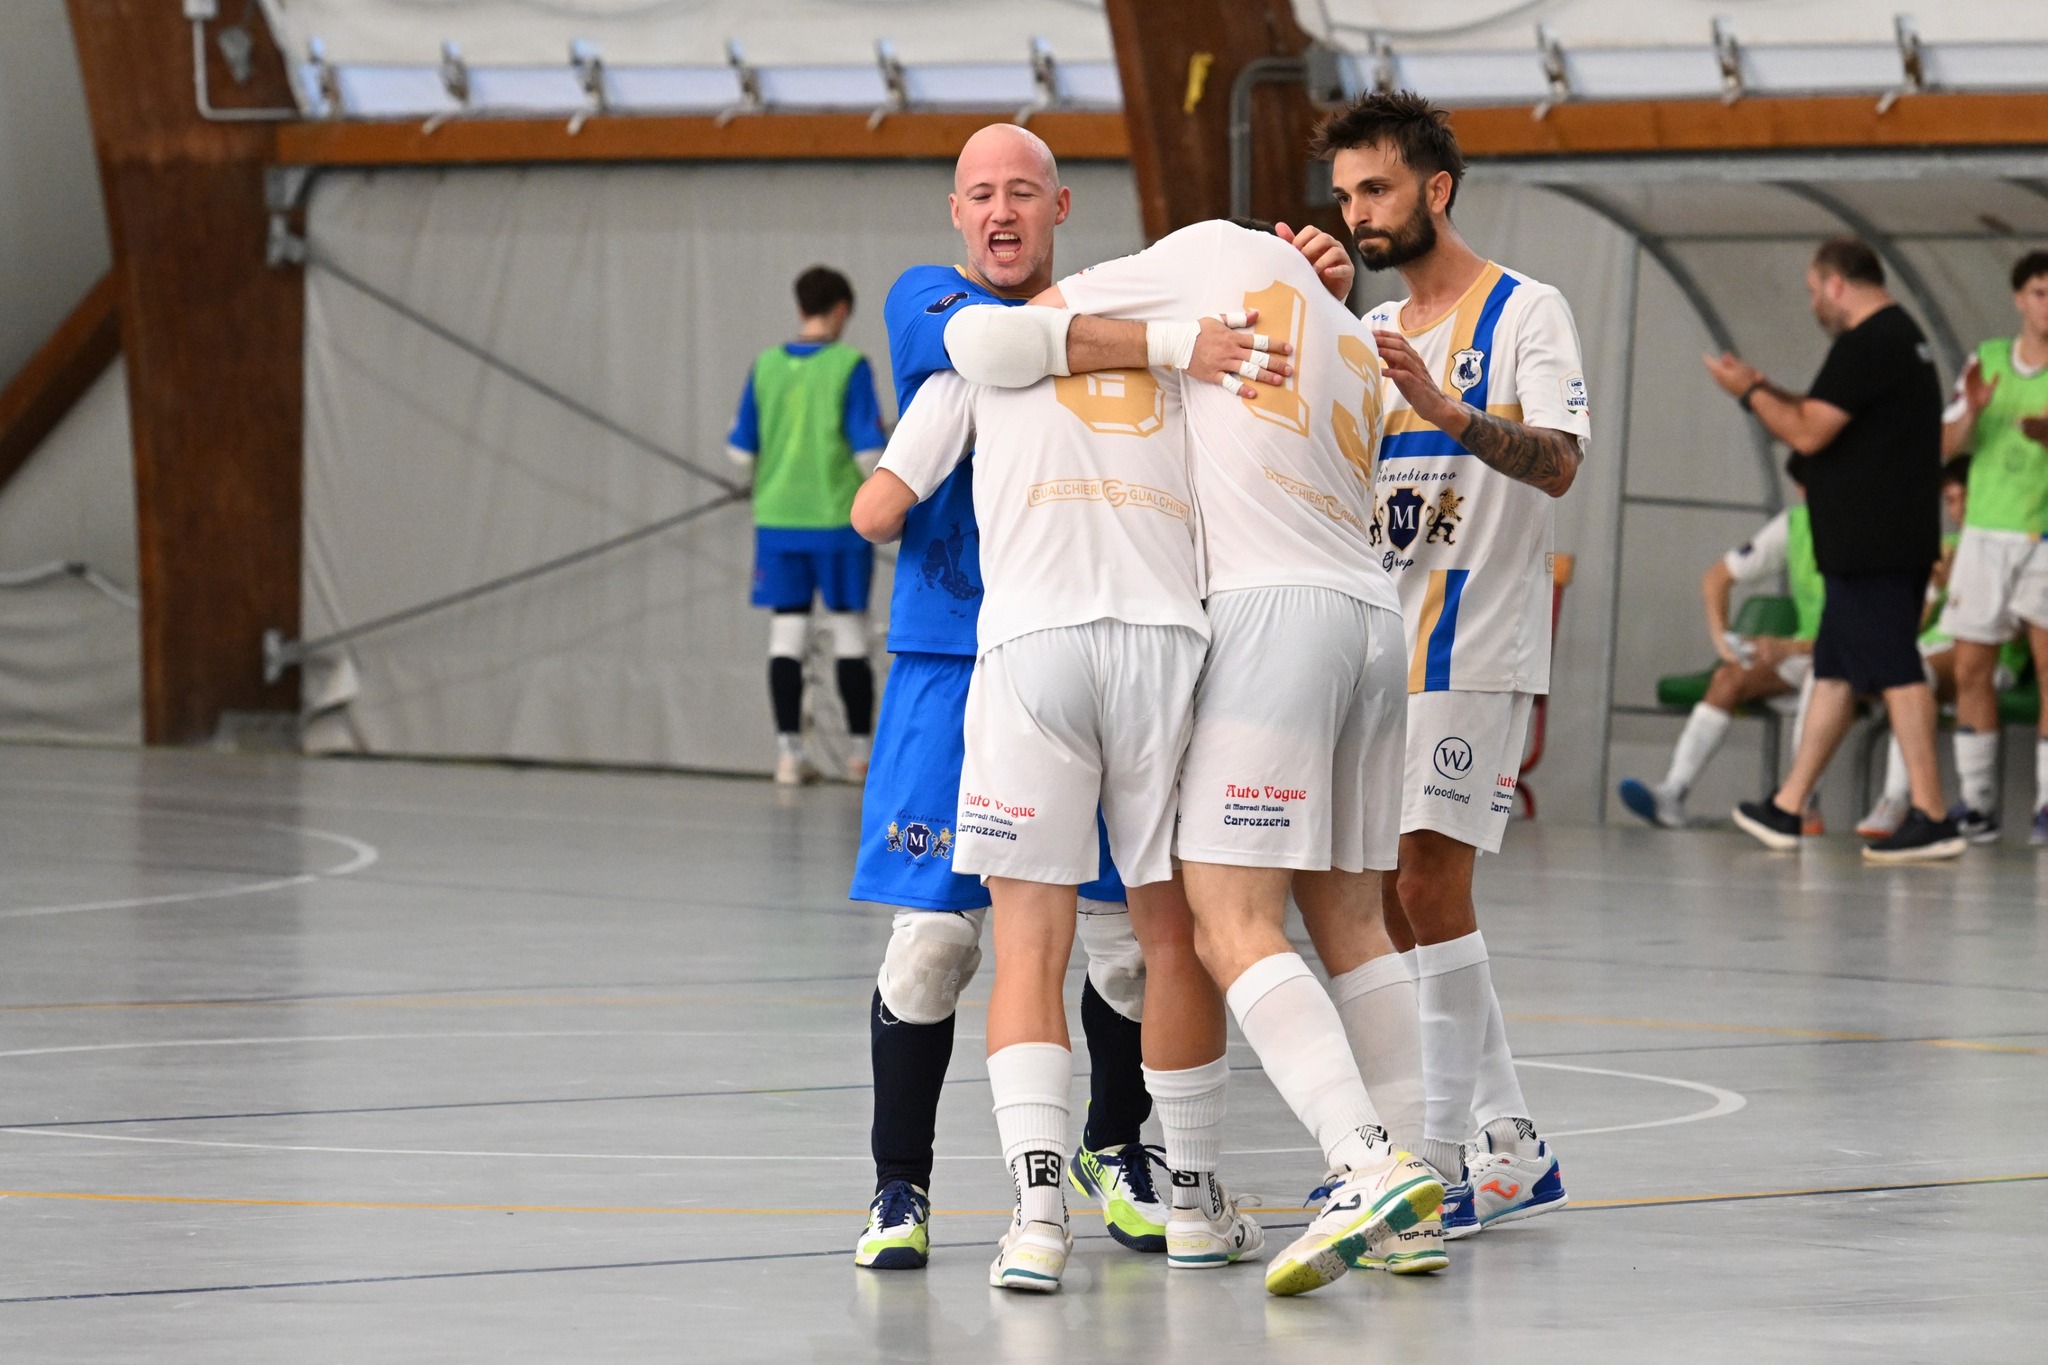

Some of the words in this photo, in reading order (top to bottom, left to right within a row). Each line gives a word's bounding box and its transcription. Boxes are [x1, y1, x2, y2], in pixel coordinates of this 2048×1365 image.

[1032, 483, 1100, 501] GUALCHIERI
[1129, 489, 1188, 520] GUALCHIERI
[1392, 505, 1416, 529] M
[1226, 784, 1260, 799] Auto
[1264, 786, 1307, 802] Vogue
[1423, 785, 1471, 804] Woodland
[995, 799, 1036, 818] Vogue
[1223, 815, 1291, 827] Carrozzeria
[910, 832, 925, 848] M
[1028, 1153, 1060, 1184] FS
